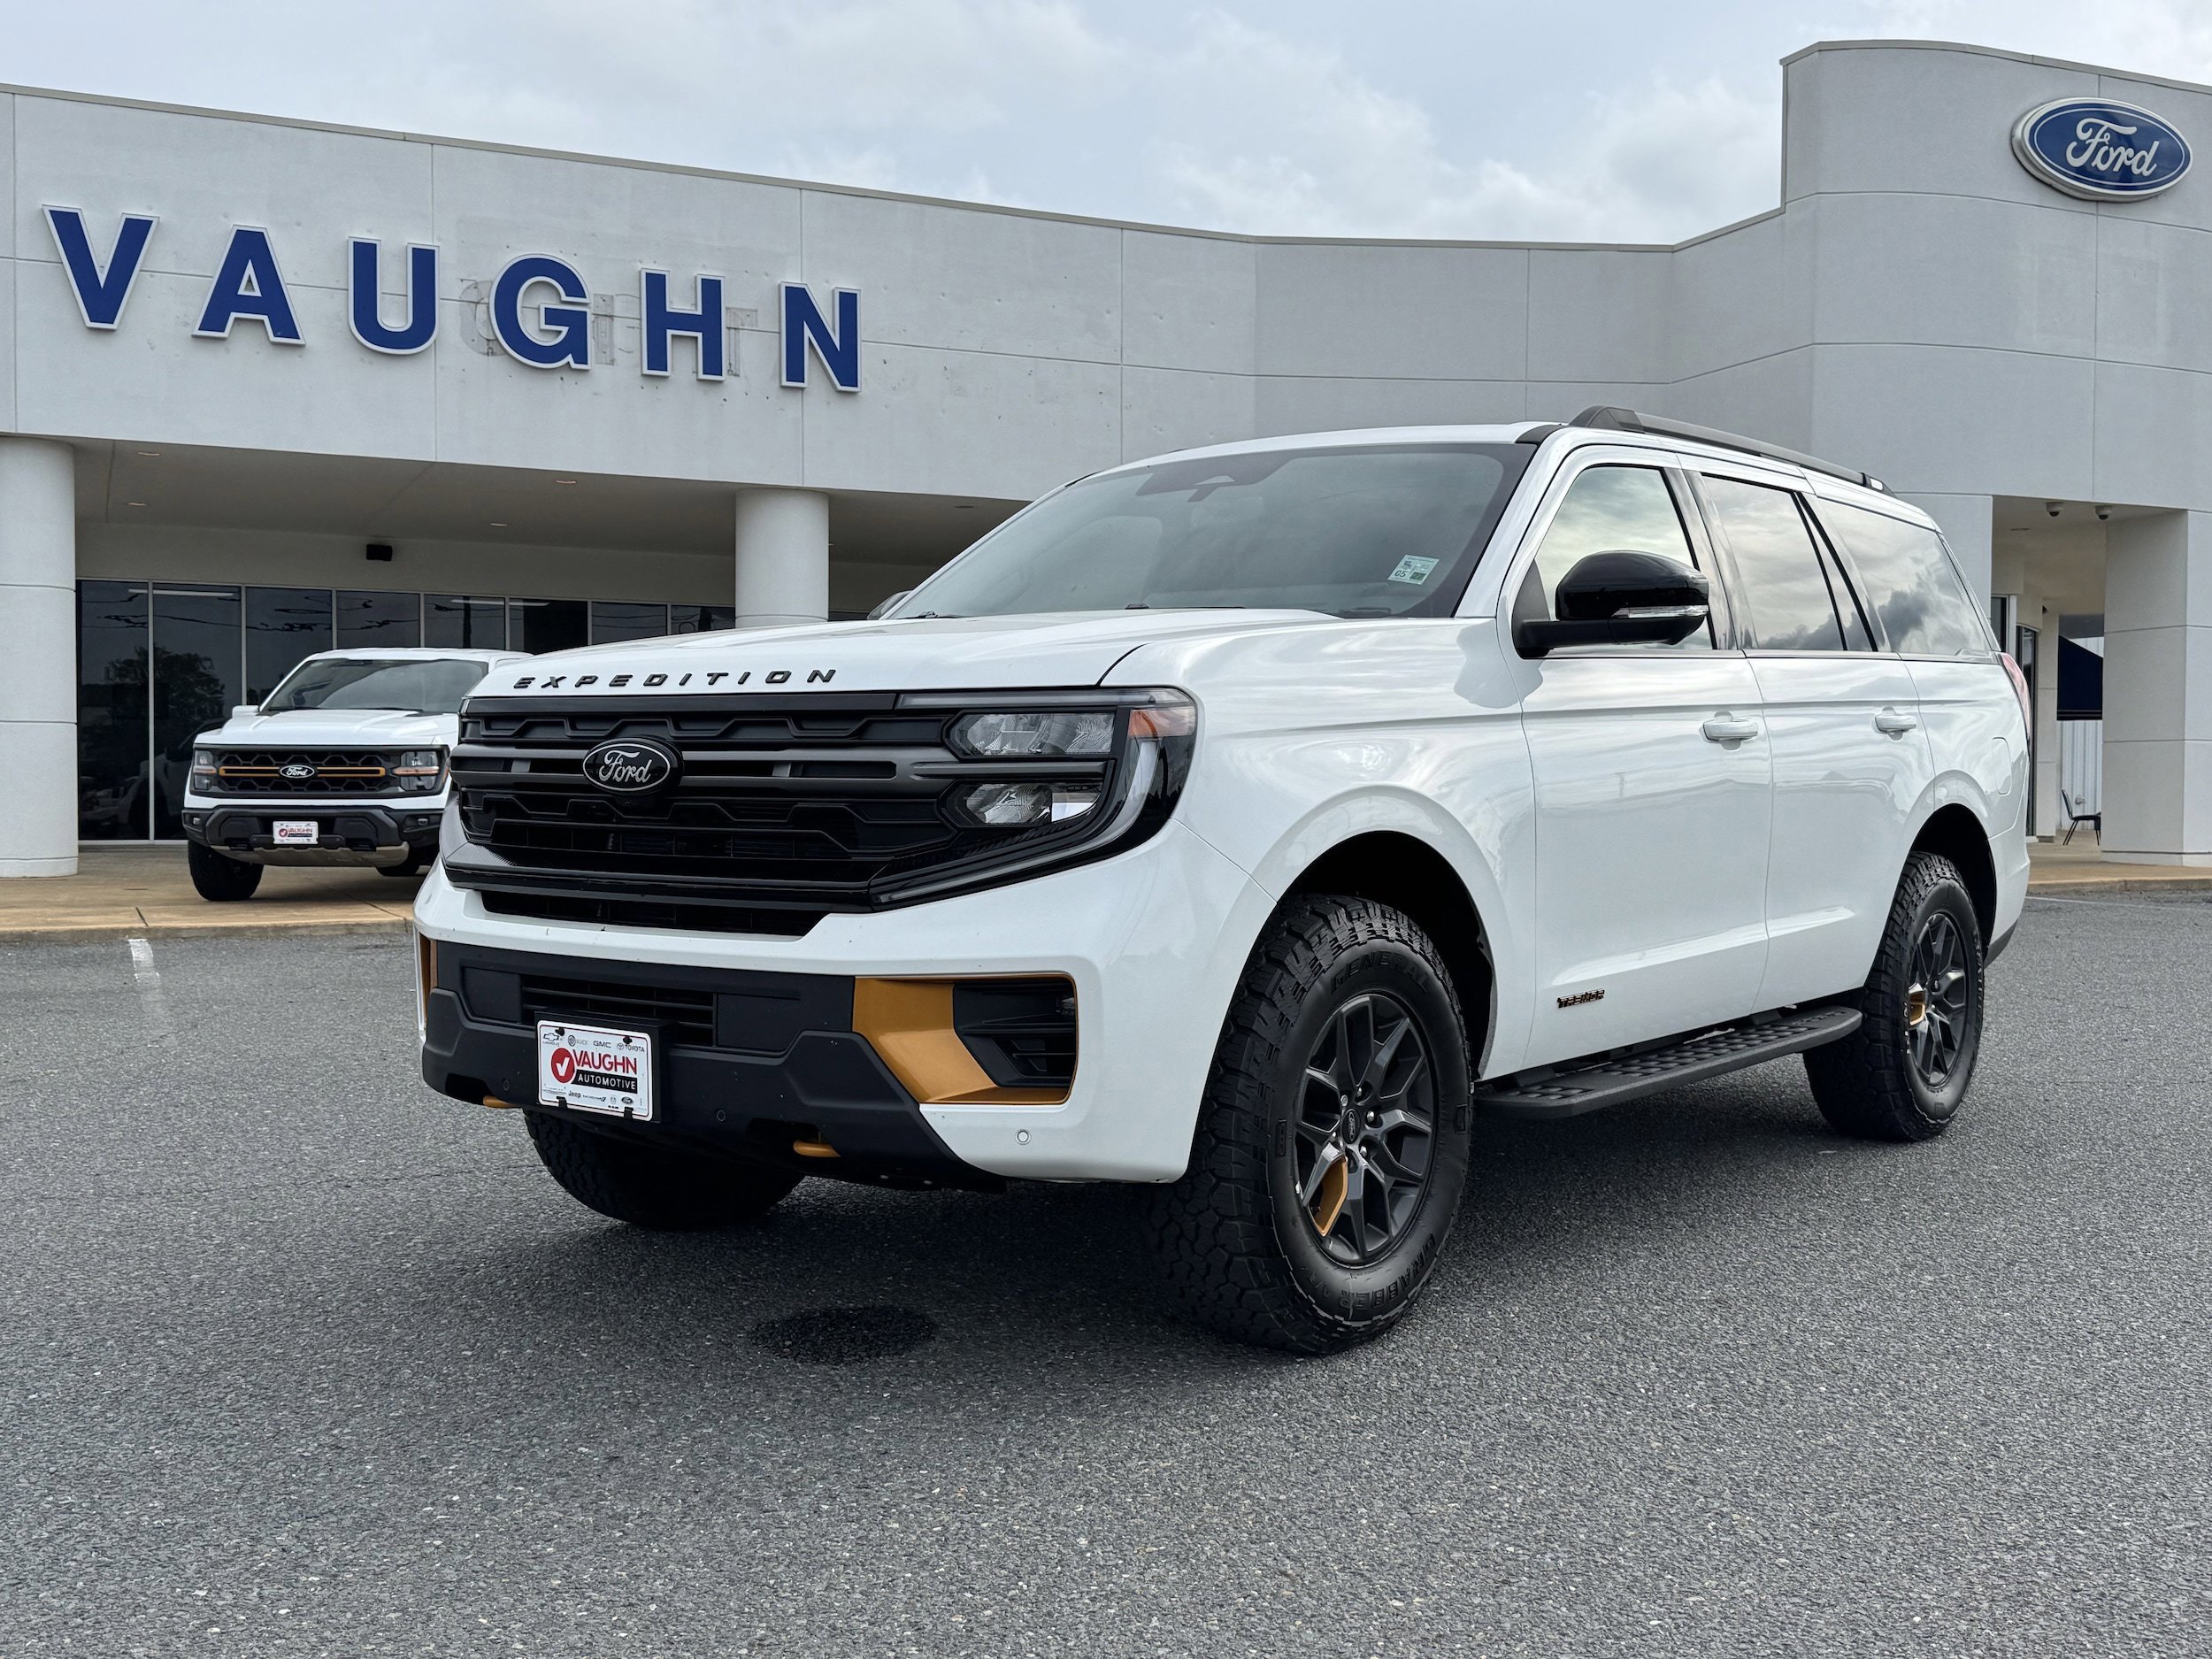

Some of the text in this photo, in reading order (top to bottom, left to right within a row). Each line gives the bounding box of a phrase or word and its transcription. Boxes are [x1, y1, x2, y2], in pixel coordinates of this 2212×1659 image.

[2066, 118, 2160, 177] Ford
[42, 204, 862, 392] VAUGHN
[513, 669, 836, 689] EXPEDITION
[286, 766, 308, 776] Ford
[599, 749, 652, 783] Ford
[572, 1049, 637, 1075] VAUGHN
[578, 1073, 636, 1090] AUTOMOTIVE
[568, 1090, 581, 1099] Jeep
